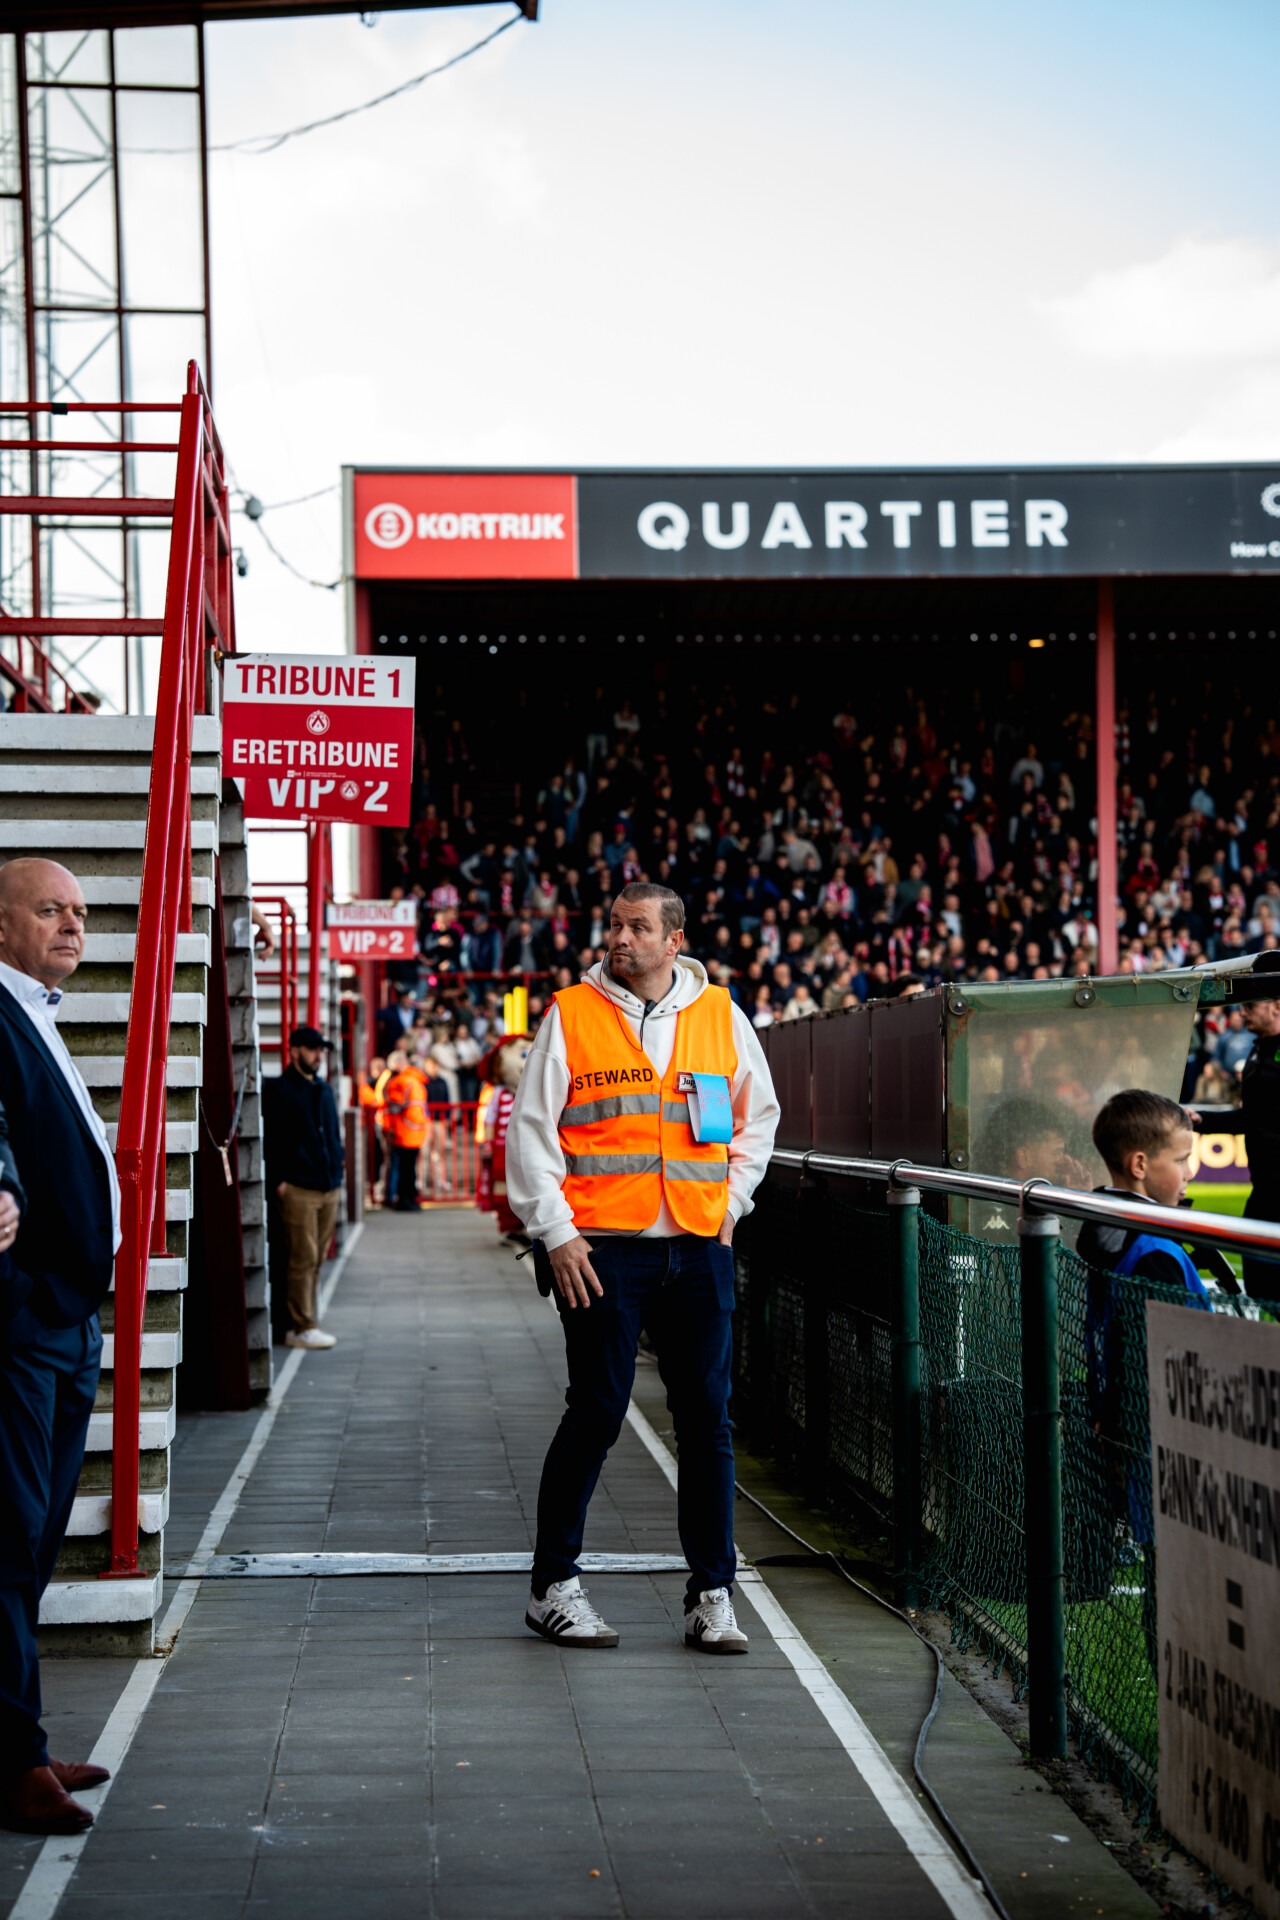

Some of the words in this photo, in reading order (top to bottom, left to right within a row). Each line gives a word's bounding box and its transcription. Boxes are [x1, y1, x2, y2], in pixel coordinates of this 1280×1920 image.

[416, 513, 565, 539] KORTRIJK
[637, 499, 1069, 552] QUARTIER
[236, 664, 376, 697] TRIBUNE
[387, 669, 400, 698] 1
[232, 738, 399, 768] ERETRIBUNE
[268, 778, 336, 809] VIP
[363, 780, 389, 812] 2
[338, 930, 376, 954] VIP
[389, 930, 405, 954] 2
[574, 1068, 653, 1091] STEWARD
[1165, 1638, 1173, 1700] 2
